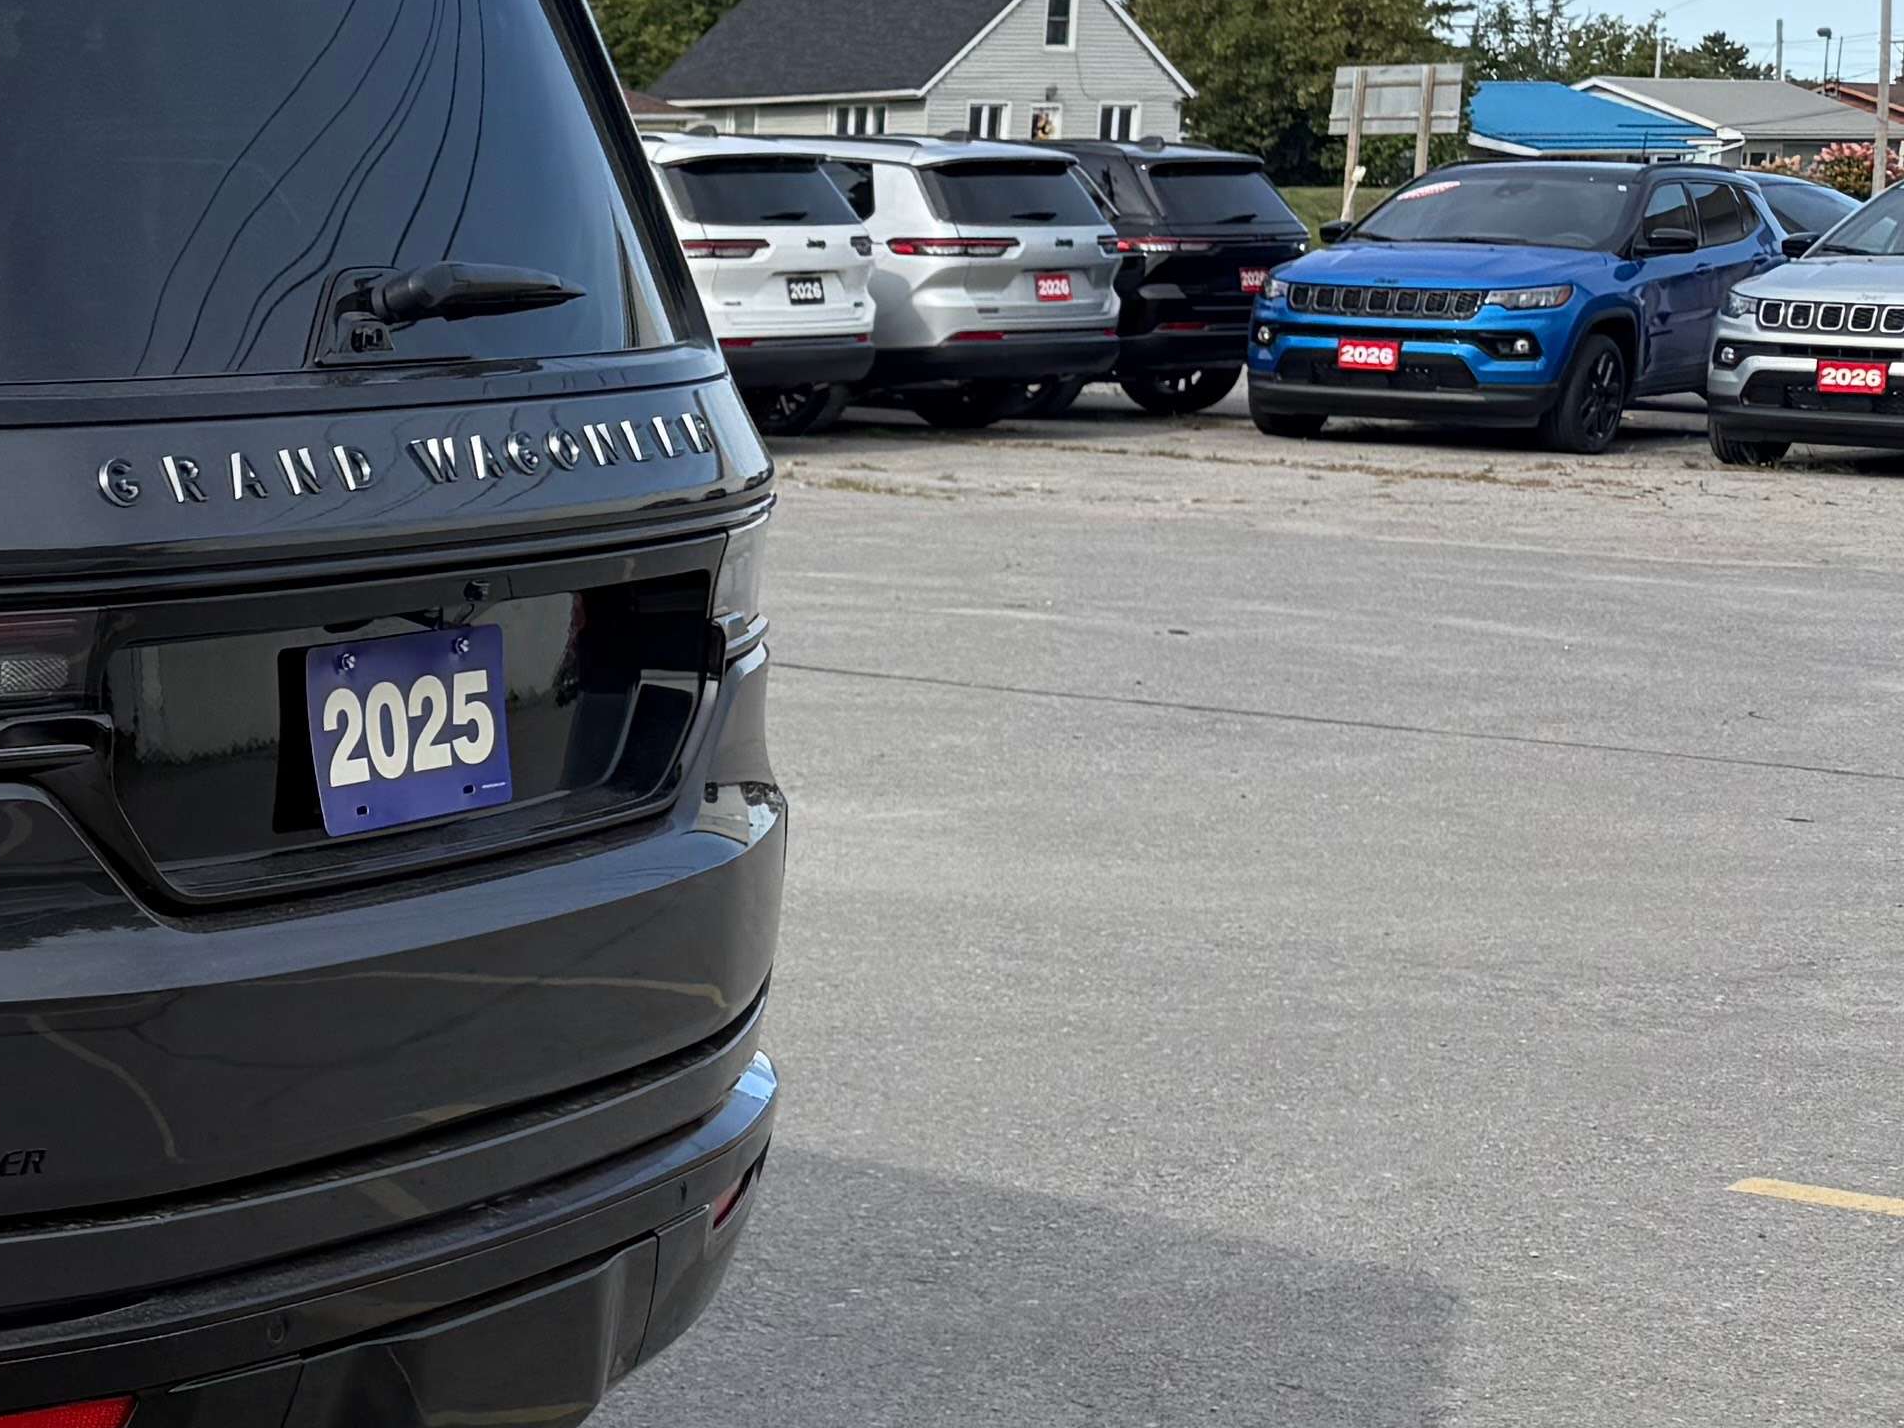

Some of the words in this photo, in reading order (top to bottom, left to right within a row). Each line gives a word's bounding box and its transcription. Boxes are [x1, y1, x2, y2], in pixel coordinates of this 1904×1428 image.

[790, 282, 822, 299] 2026
[1038, 280, 1070, 297] 2026
[1341, 345, 1394, 365] 2026
[1820, 367, 1882, 387] 2026
[98, 445, 374, 507] GRAND
[323, 670, 495, 787] 2025
